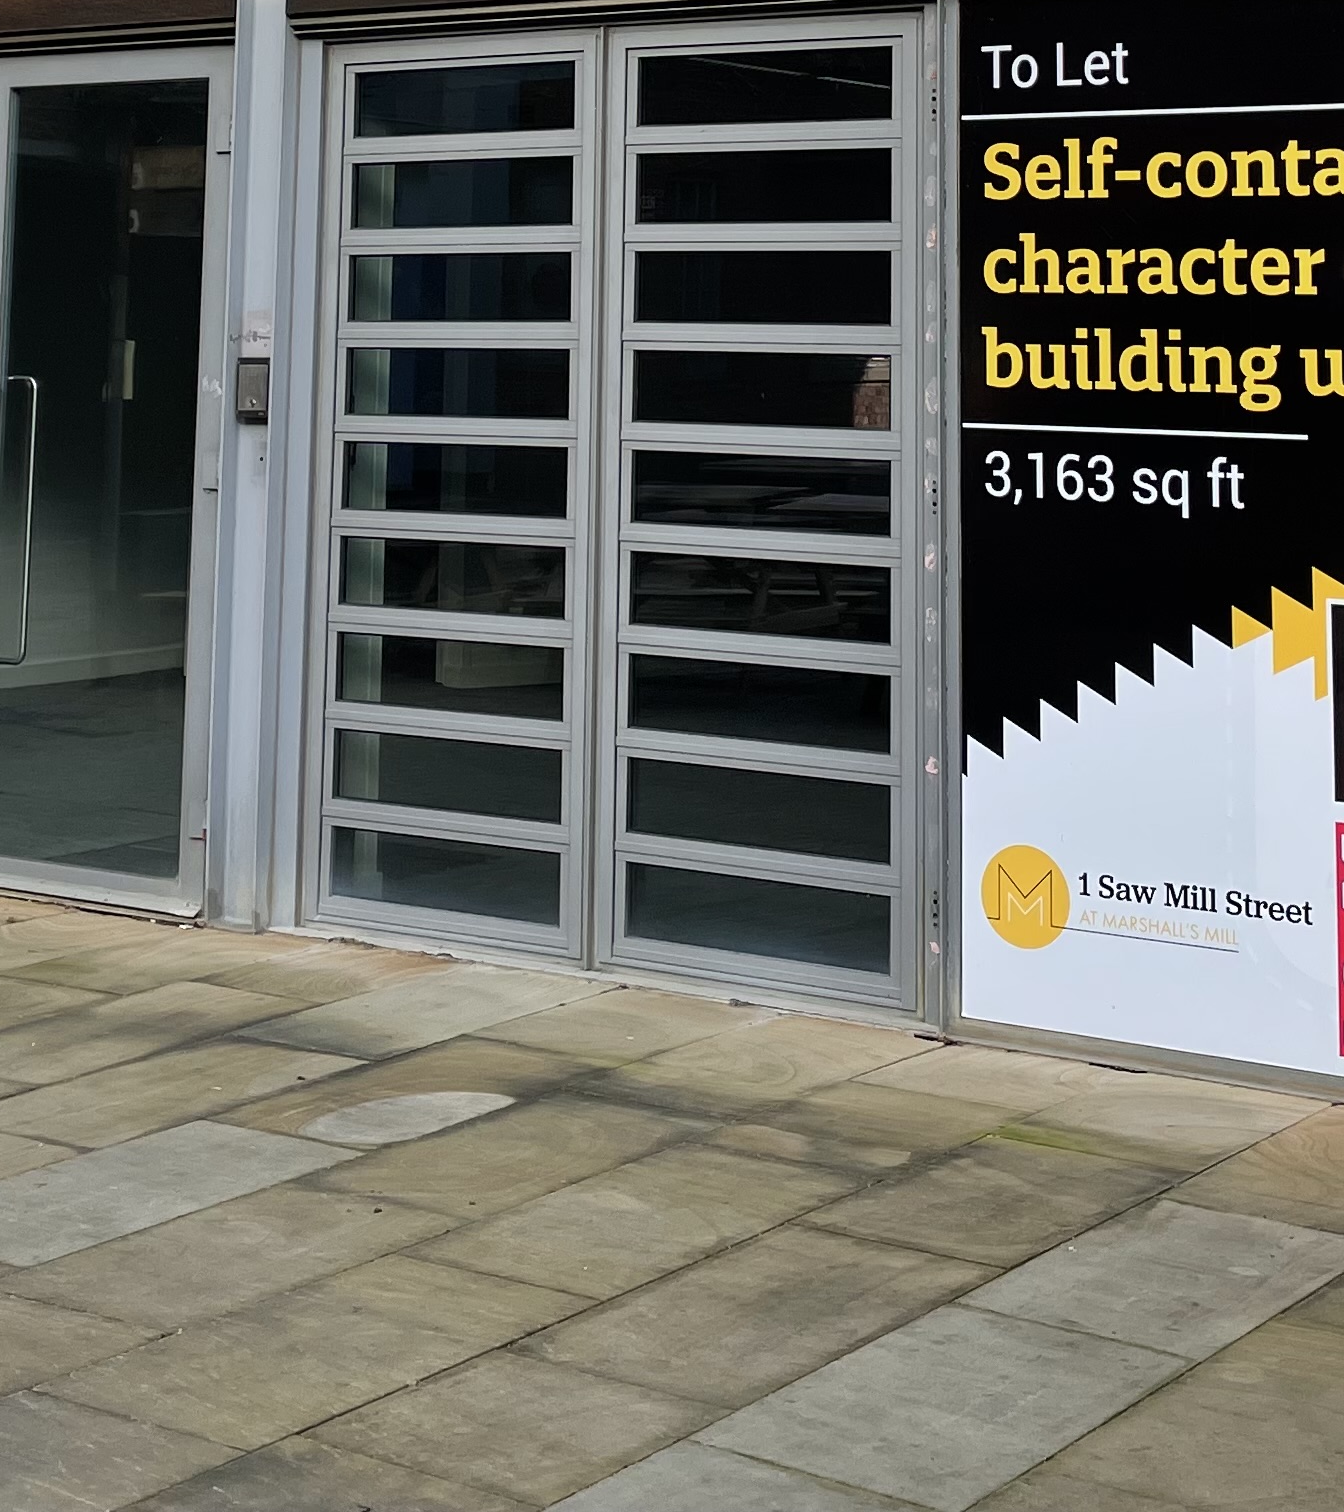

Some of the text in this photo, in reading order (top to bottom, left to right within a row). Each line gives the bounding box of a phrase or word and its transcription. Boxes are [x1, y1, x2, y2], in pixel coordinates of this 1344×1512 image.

[980, 42, 1129, 89] To Let
[983, 232, 1326, 296] character
[981, 326, 1282, 412] building
[984, 450, 1245, 519] 3,163 sq ft
[1078, 872, 1313, 926] 1 Saw Mill Street
[1078, 909, 1239, 946] AT MARSHALL'S MILL
